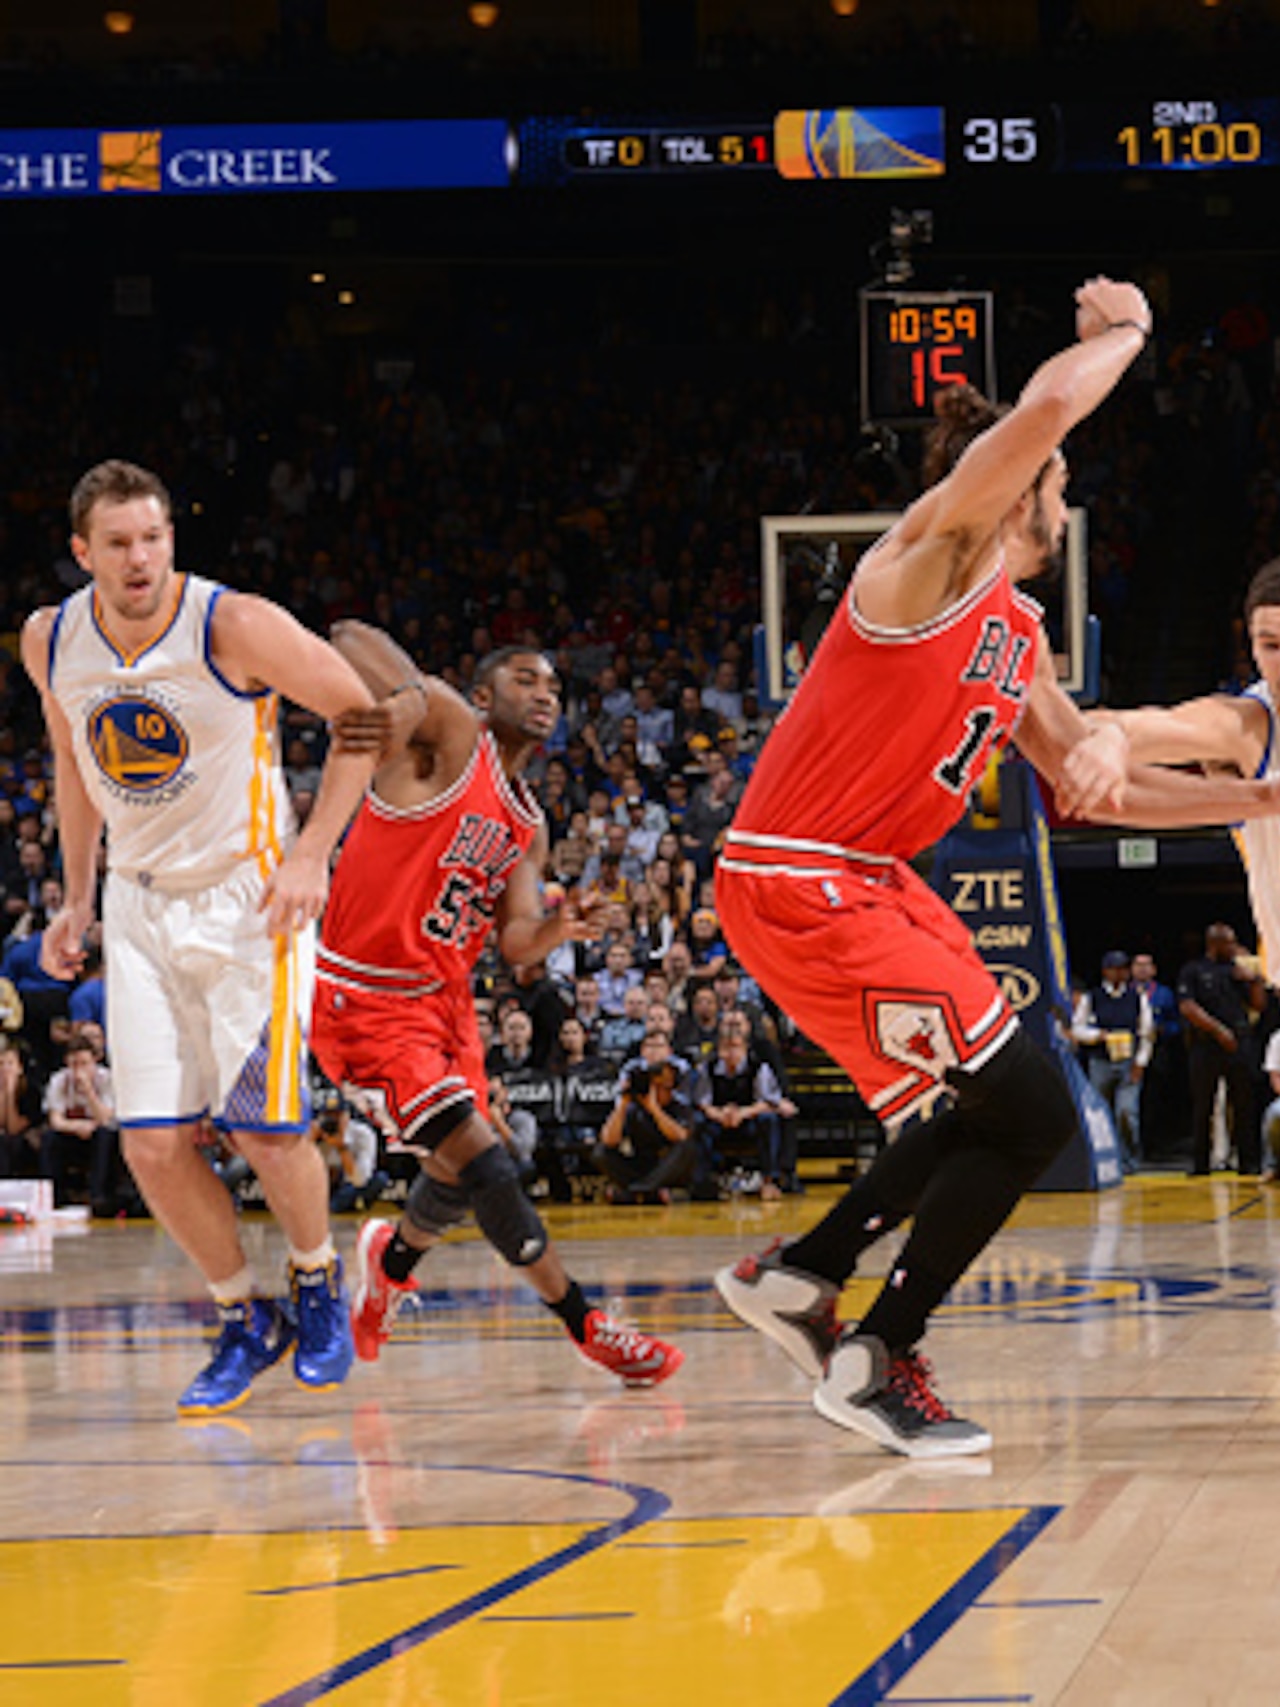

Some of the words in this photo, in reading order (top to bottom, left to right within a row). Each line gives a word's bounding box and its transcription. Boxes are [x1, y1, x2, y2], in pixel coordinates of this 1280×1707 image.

[1153, 102, 1218, 126] 2ND
[583, 139, 615, 165] TF
[662, 139, 714, 164] TOL
[962, 117, 1037, 162] 35
[1117, 122, 1262, 167] 11:00
[167, 149, 338, 187] CREEK
[889, 304, 977, 344] 10:59
[136, 713, 167, 740] 10
[951, 868, 1024, 912] ZTE
